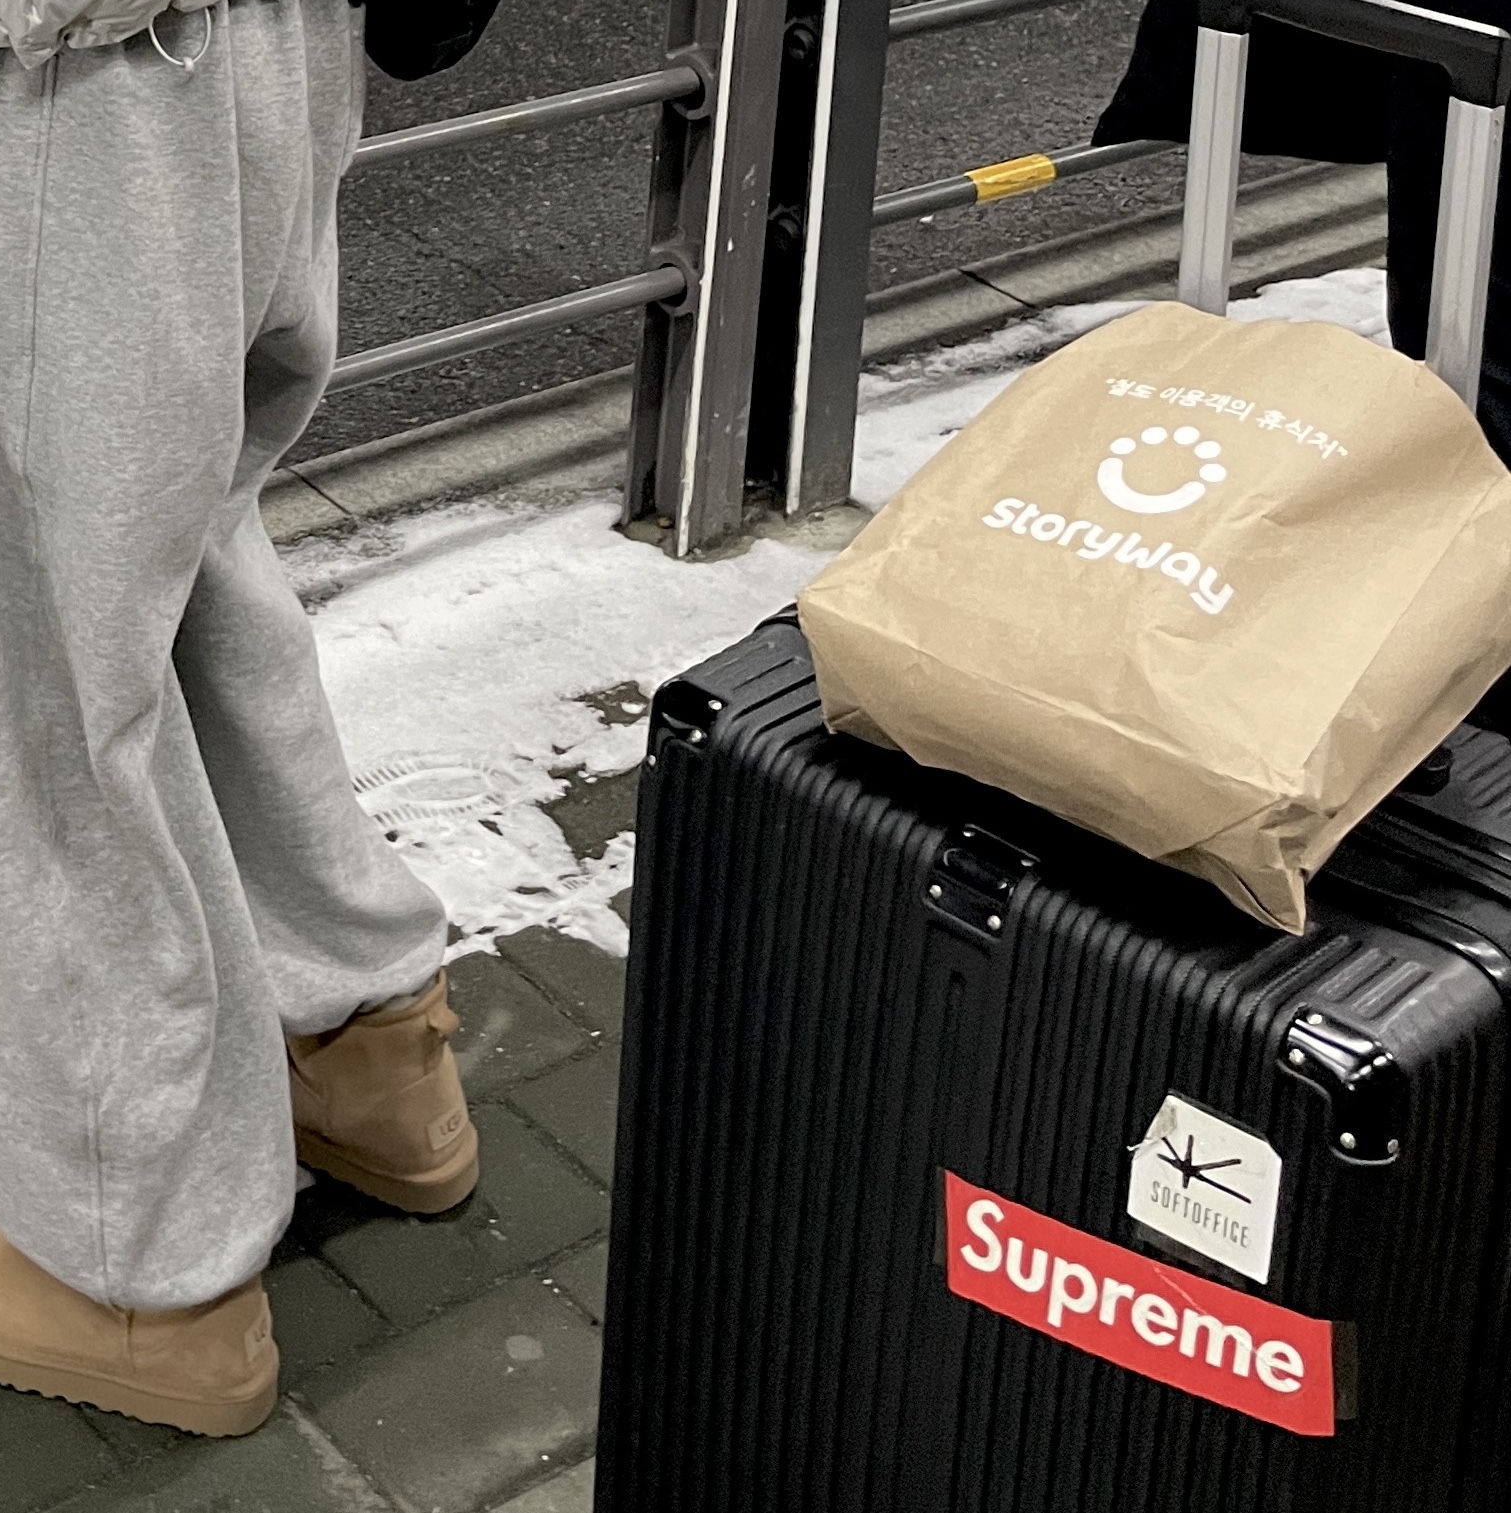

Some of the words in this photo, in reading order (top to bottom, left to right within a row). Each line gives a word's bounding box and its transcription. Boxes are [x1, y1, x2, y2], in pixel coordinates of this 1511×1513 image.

[1159, 387, 1255, 421] 이용객의
[1150, 1180, 1249, 1249] SOFTOFFICE
[960, 1199, 1304, 1393] Supreme
